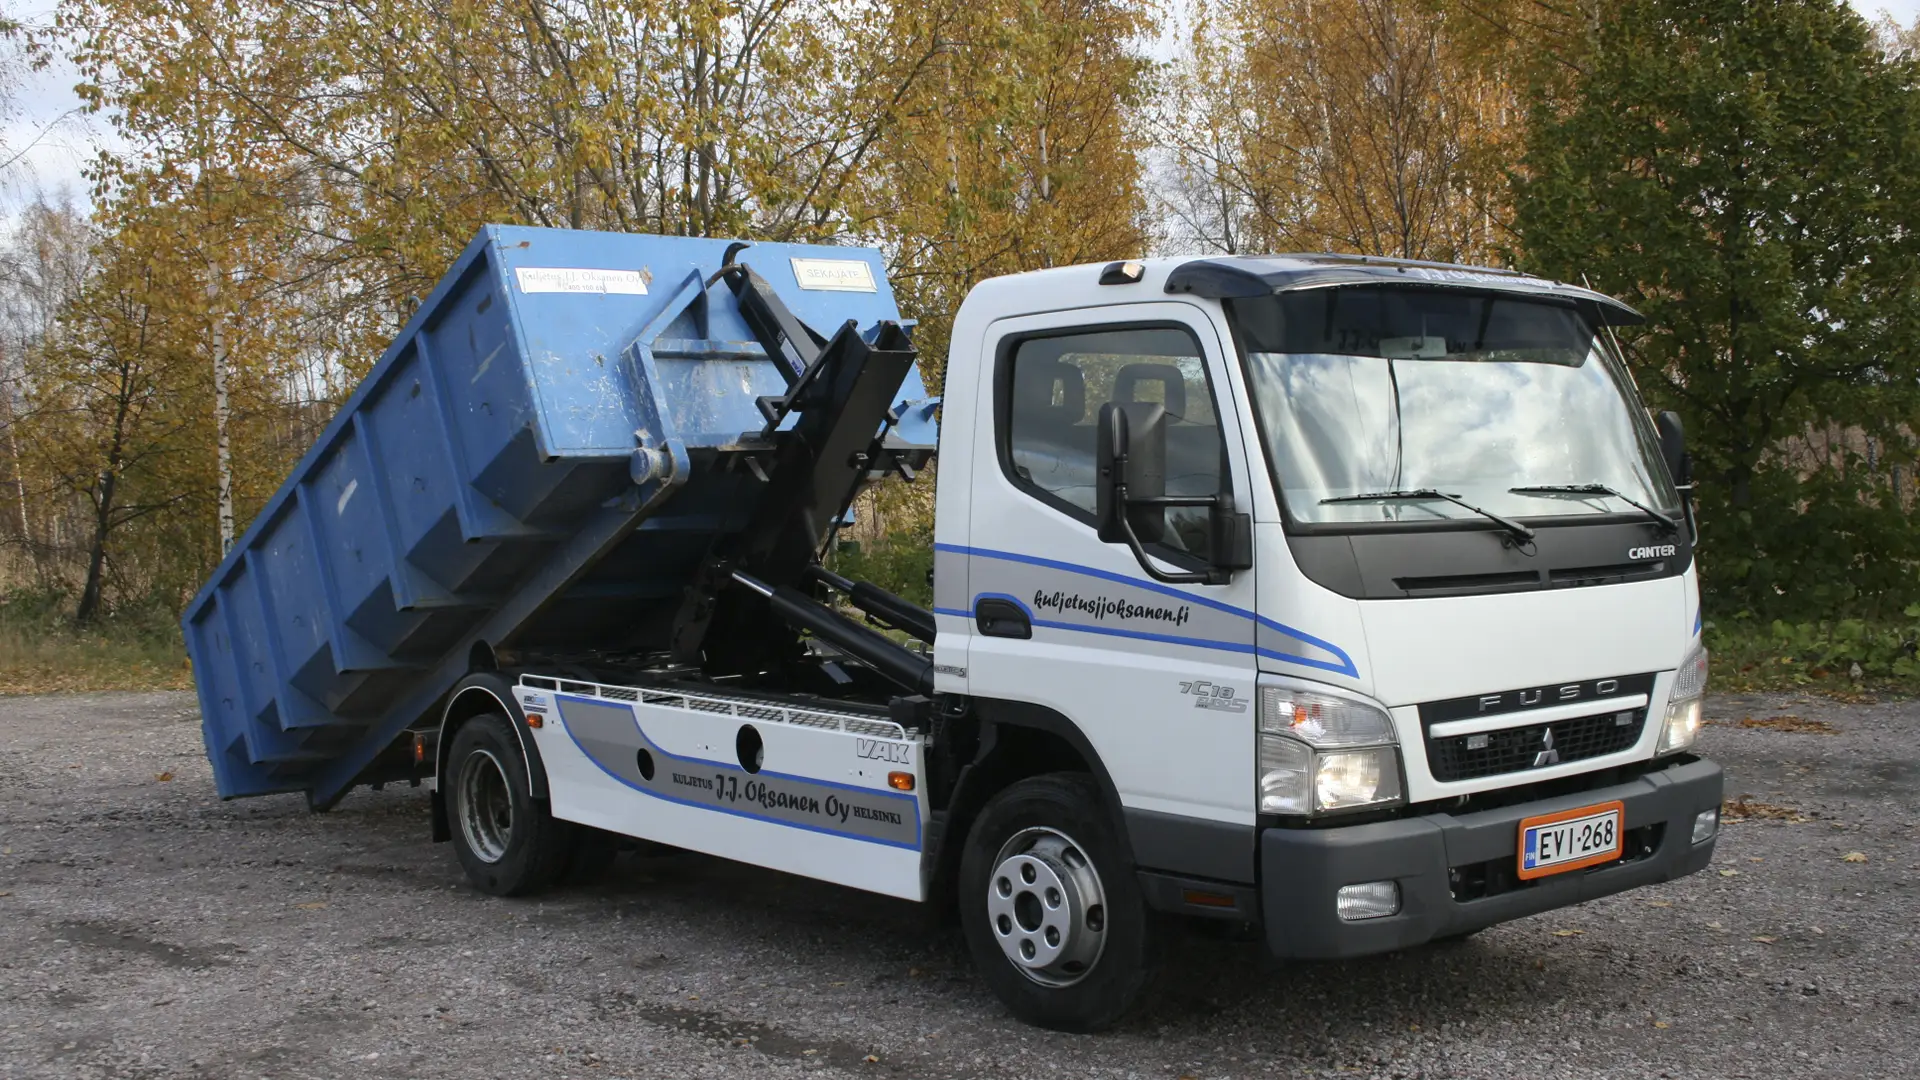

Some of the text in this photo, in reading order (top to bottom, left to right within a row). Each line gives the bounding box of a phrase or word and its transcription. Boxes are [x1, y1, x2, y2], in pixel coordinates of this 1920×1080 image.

[582, 271, 623, 283] Oksanen
[626, 273, 640, 285] Oy
[1628, 544, 1676, 560] CANTER
[1033, 589, 1189, 626] kuljetusjjoksanen.fi
[1178, 680, 1236, 700] 7C18
[1478, 679, 1618, 712] FUSO
[856, 737, 910, 764] VAK
[672, 772, 902, 824] KULJETUS J.J. Oksanen Oy HELSINKI
[1540, 819, 1614, 860] EVI-268
[1525, 852, 1535, 862] FIN
